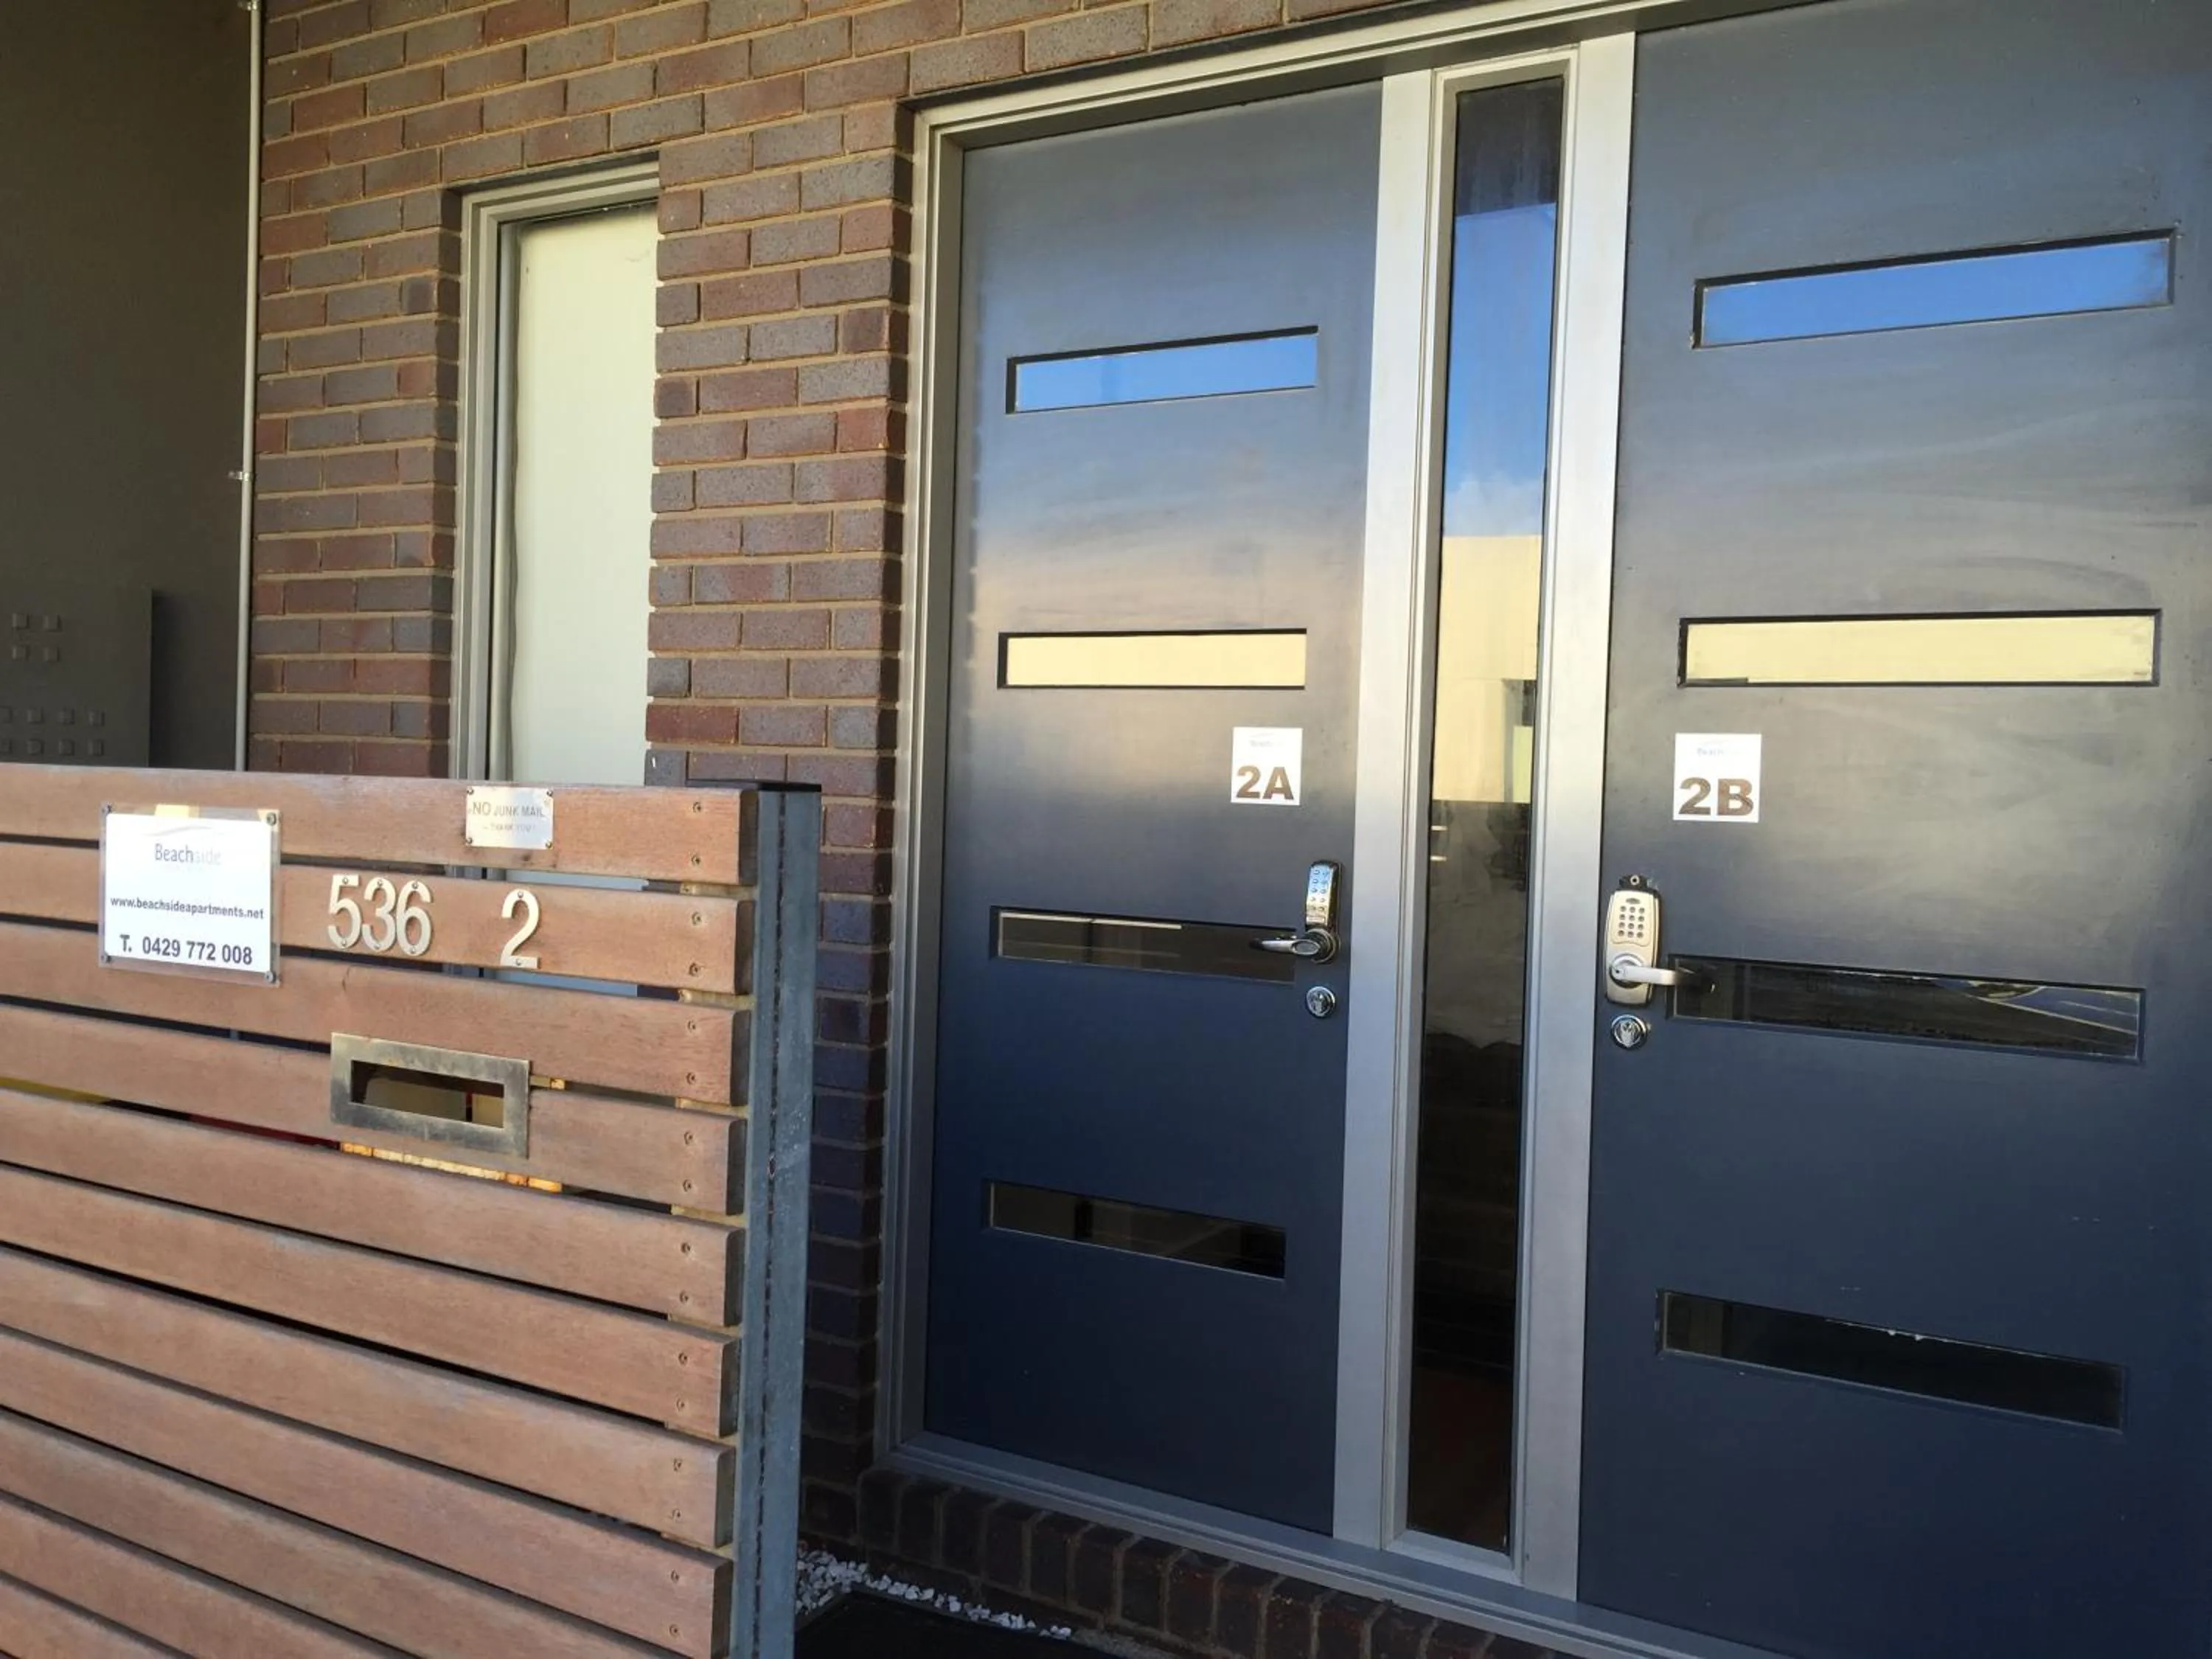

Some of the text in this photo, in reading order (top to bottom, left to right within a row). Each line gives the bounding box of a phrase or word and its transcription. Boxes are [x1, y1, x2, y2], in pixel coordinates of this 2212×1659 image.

[1236, 765, 1294, 800] 2A
[1678, 777, 1754, 815] 2B
[473, 801, 545, 818] NO JUNK MAIL
[110, 897, 264, 920] www.beachsideapartments.net
[327, 874, 432, 956] 536
[500, 889, 540, 970] 2
[119, 933, 252, 965] T. 0429 772 008
